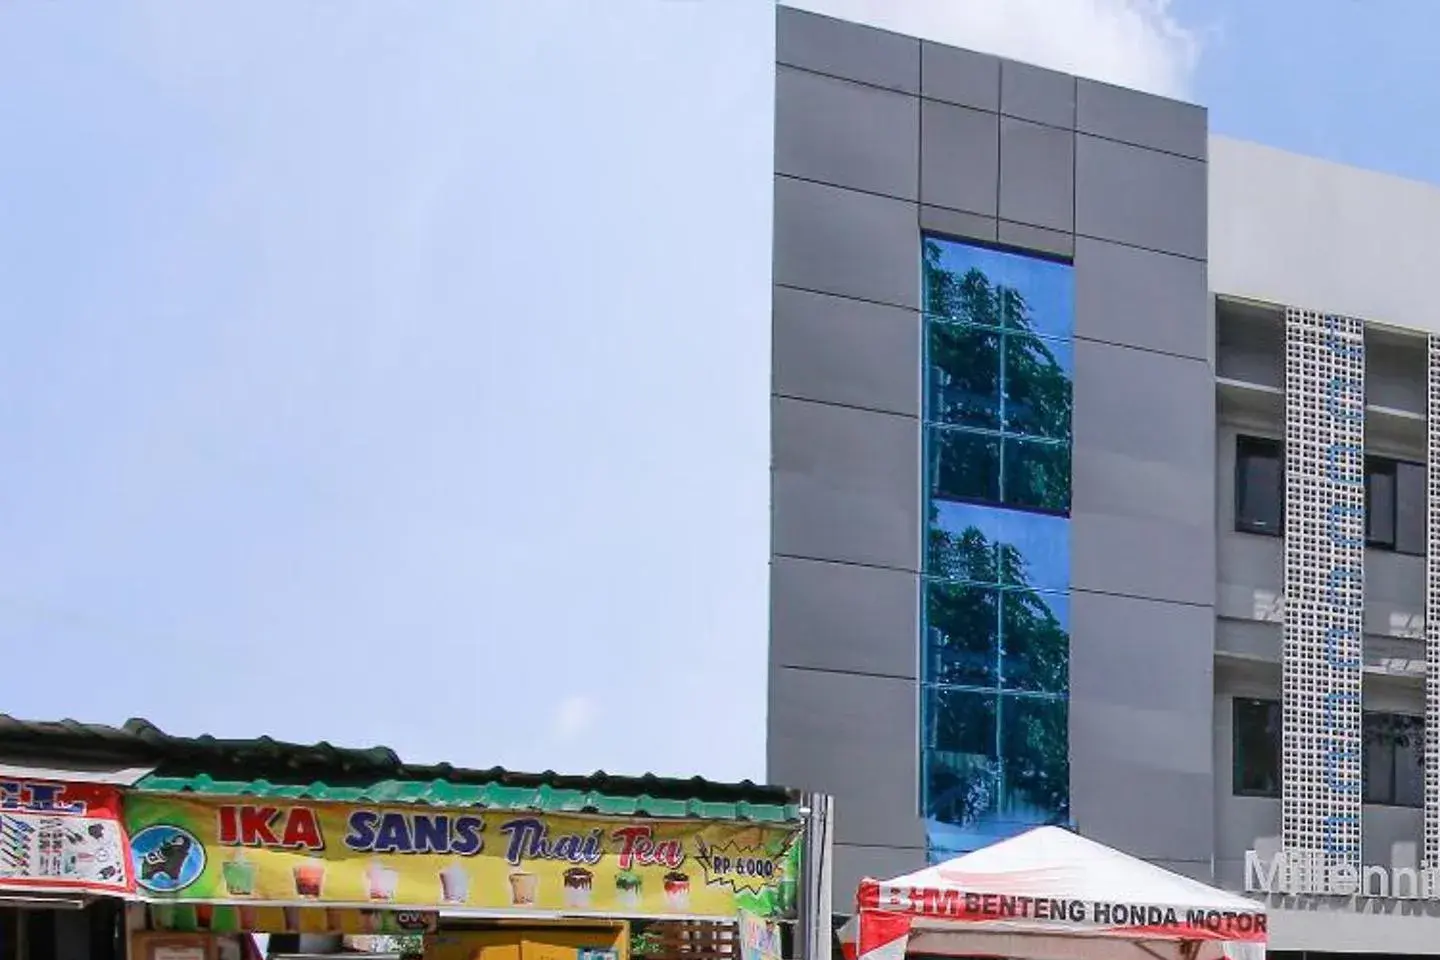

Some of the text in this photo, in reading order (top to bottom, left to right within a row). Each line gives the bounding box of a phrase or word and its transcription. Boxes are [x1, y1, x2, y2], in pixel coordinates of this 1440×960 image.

[218, 806, 685, 870] IKA SANS Thai Tea
[964, 893, 1085, 922] BENTENG
[1094, 903, 1177, 927] HONDA
[1186, 909, 1268, 933] MOTOR
